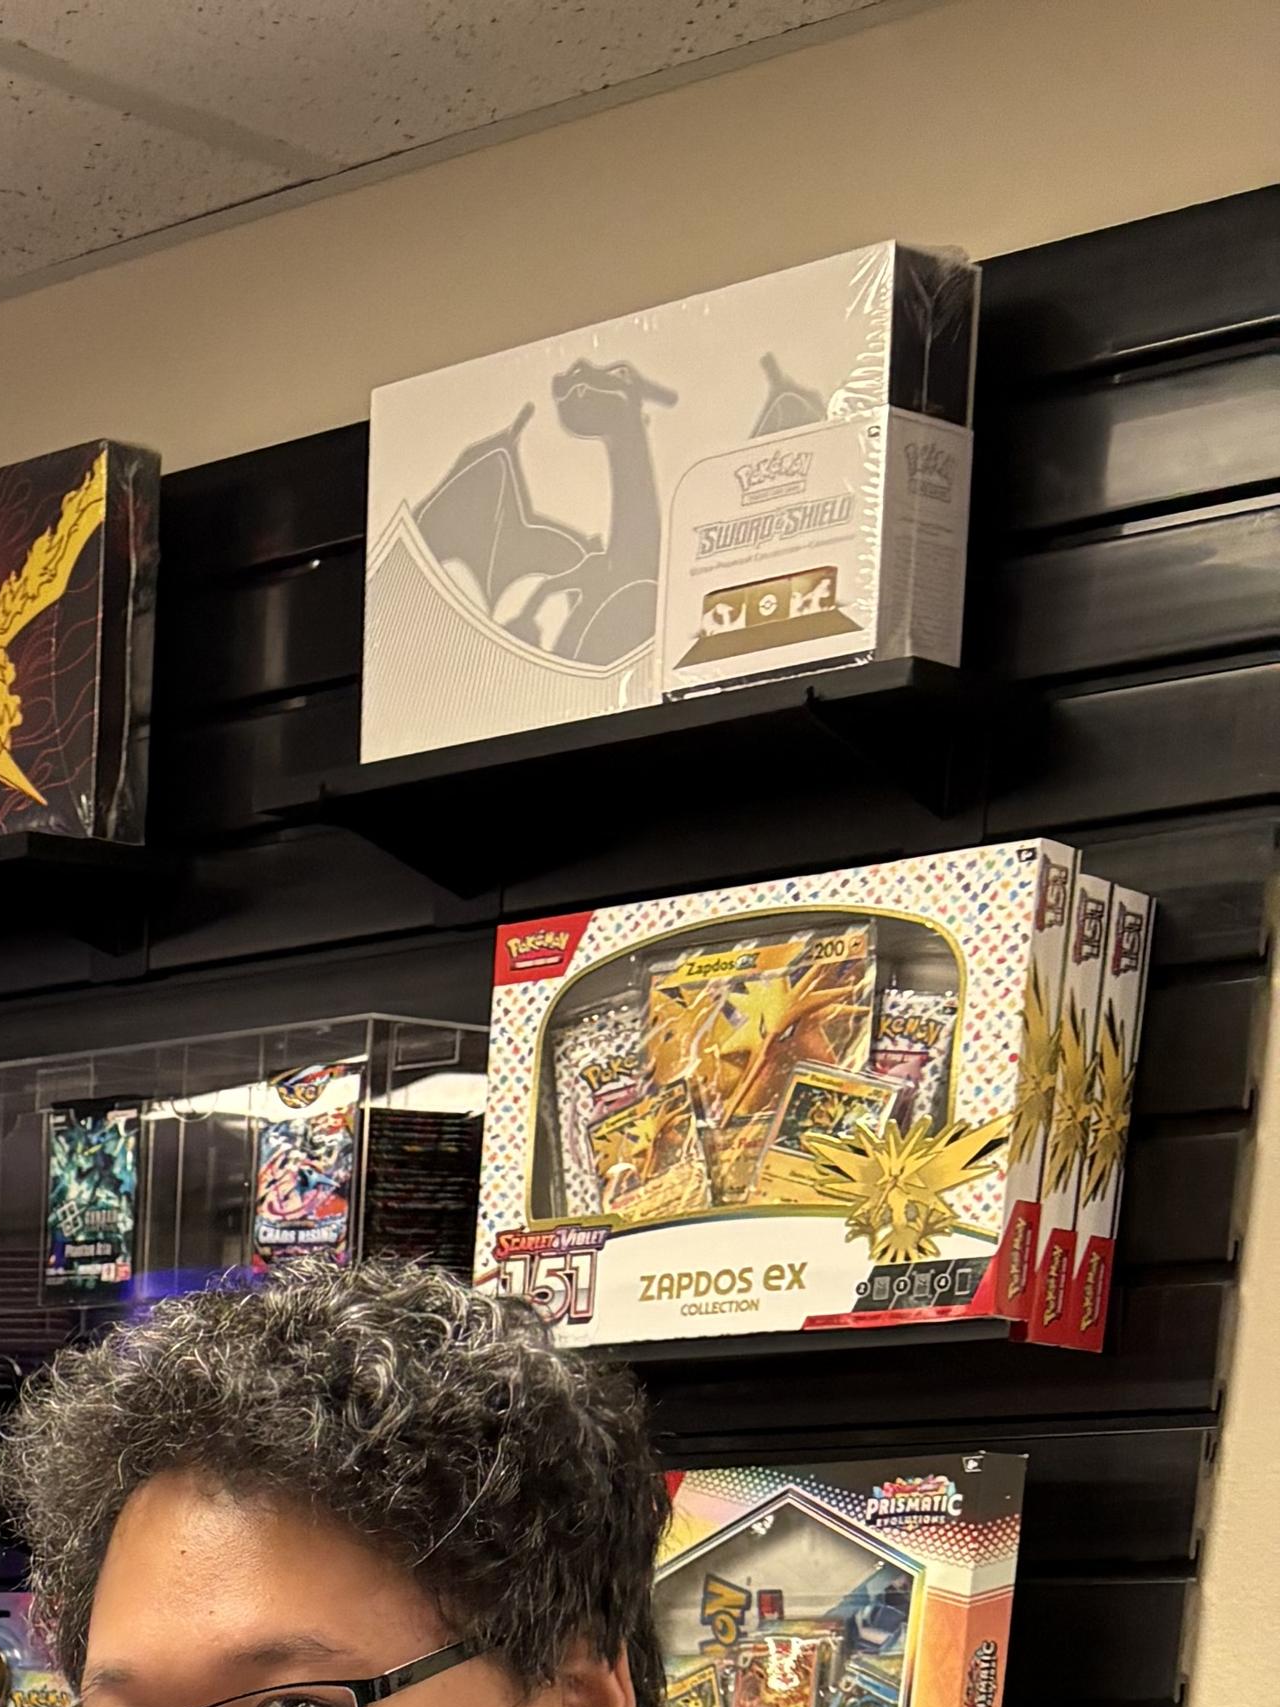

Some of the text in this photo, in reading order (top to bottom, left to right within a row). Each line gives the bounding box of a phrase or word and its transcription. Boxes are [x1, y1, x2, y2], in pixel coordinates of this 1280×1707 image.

[700, 519, 776, 556] SWORD
[781, 495, 854, 537] SHIELD
[815, 938, 845, 959] 200
[686, 956, 736, 980] Zapdos
[258, 1224, 339, 1243] CHAOS RISING
[500, 1251, 595, 1325] 151
[639, 1262, 807, 1301] ZAPDOS ex
[681, 1298, 761, 1317] COLLECTION
[866, 1494, 963, 1520] PRISMATIC
